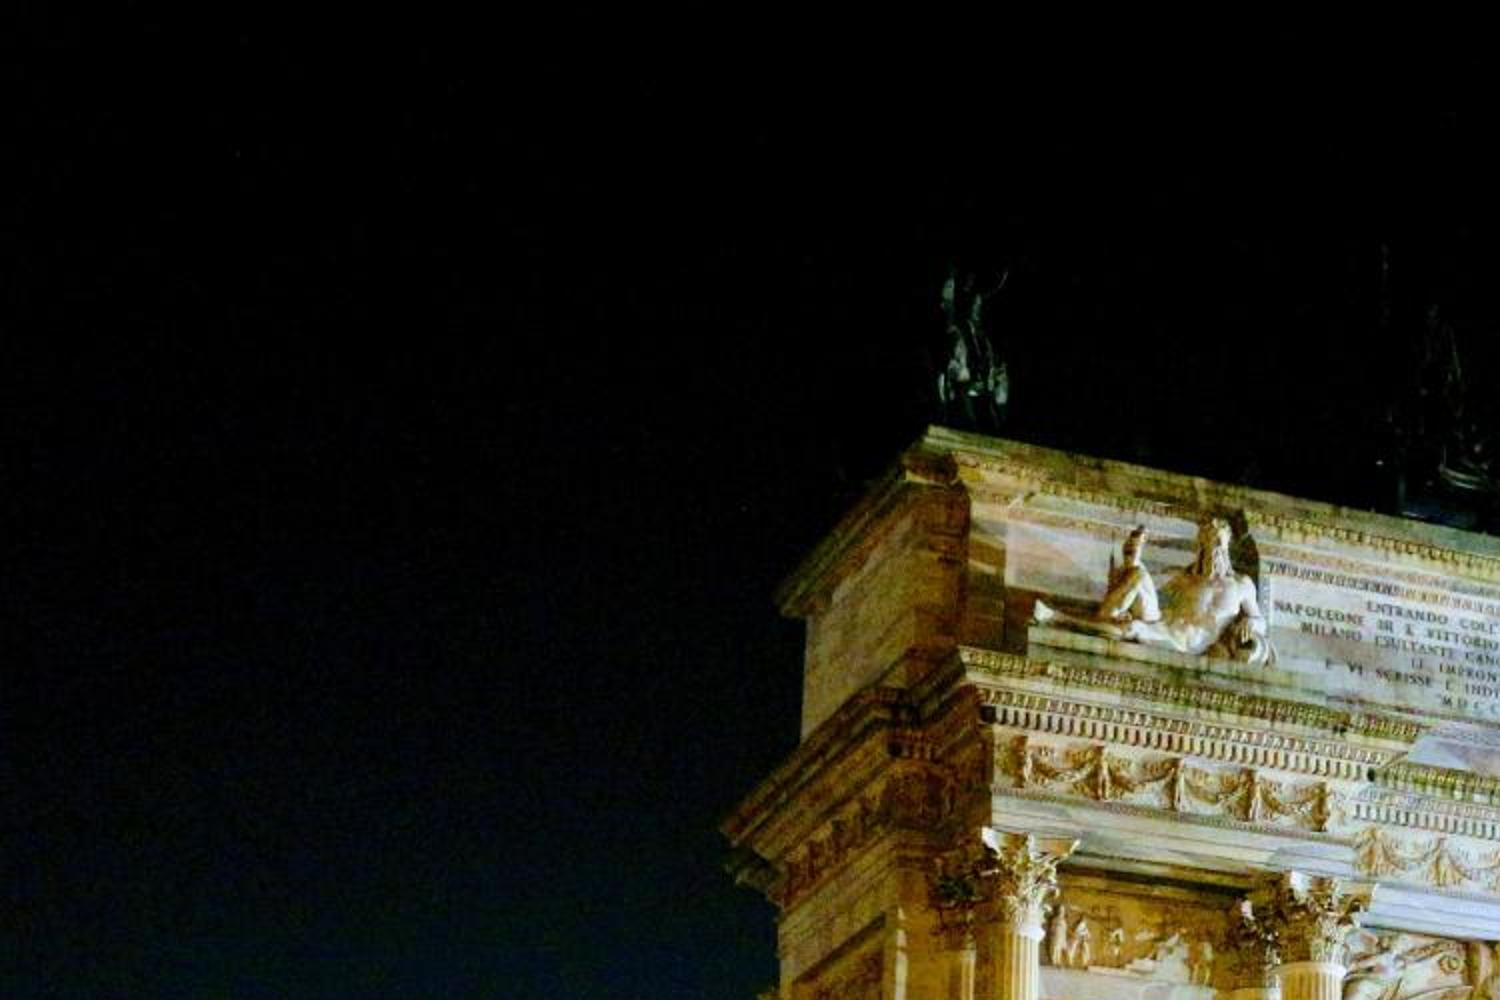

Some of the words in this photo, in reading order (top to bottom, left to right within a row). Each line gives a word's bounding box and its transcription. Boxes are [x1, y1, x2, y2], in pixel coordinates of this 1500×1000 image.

[1274, 600, 1364, 624] NAPOLEONE
[1428, 628, 1499, 650] VITTORIO
[1301, 622, 1362, 640] MILANO
